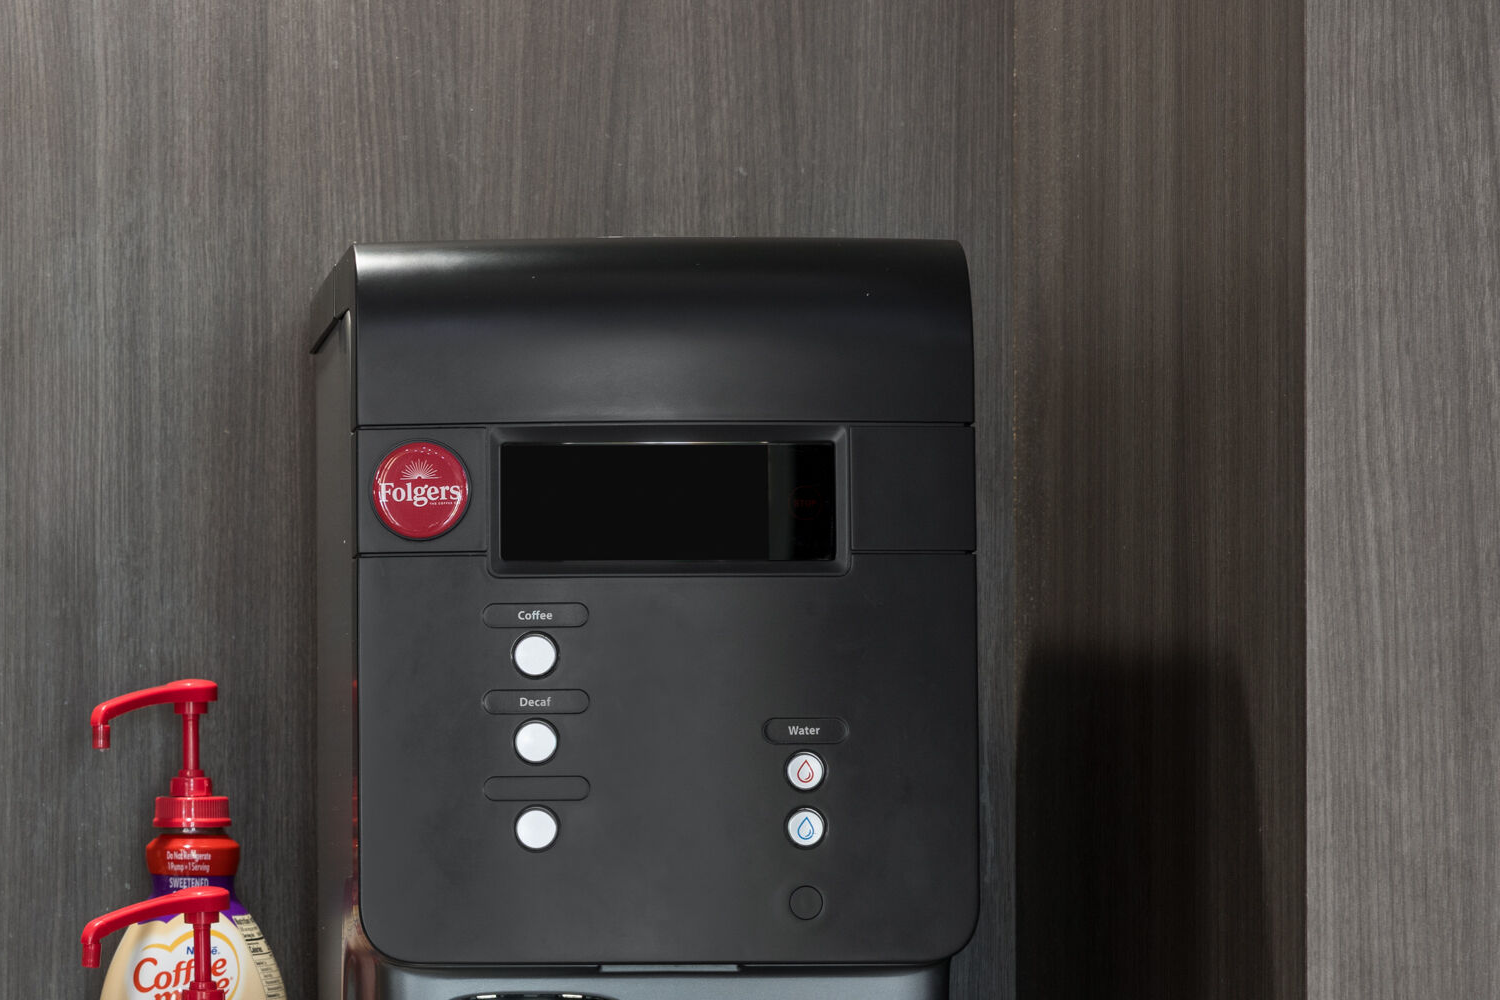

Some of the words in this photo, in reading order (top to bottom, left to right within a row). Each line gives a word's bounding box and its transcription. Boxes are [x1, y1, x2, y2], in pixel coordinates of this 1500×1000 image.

[379, 482, 462, 508] Folgers
[517, 610, 553, 621] Coffee
[519, 696, 552, 707] Decaf
[787, 725, 821, 736] Water
[166, 850, 173, 860] Do
[171, 862, 184, 873] Pump
[191, 863, 210, 873] Serving
[169, 877, 210, 889] SWEETENED
[133, 957, 228, 993] Coffe
